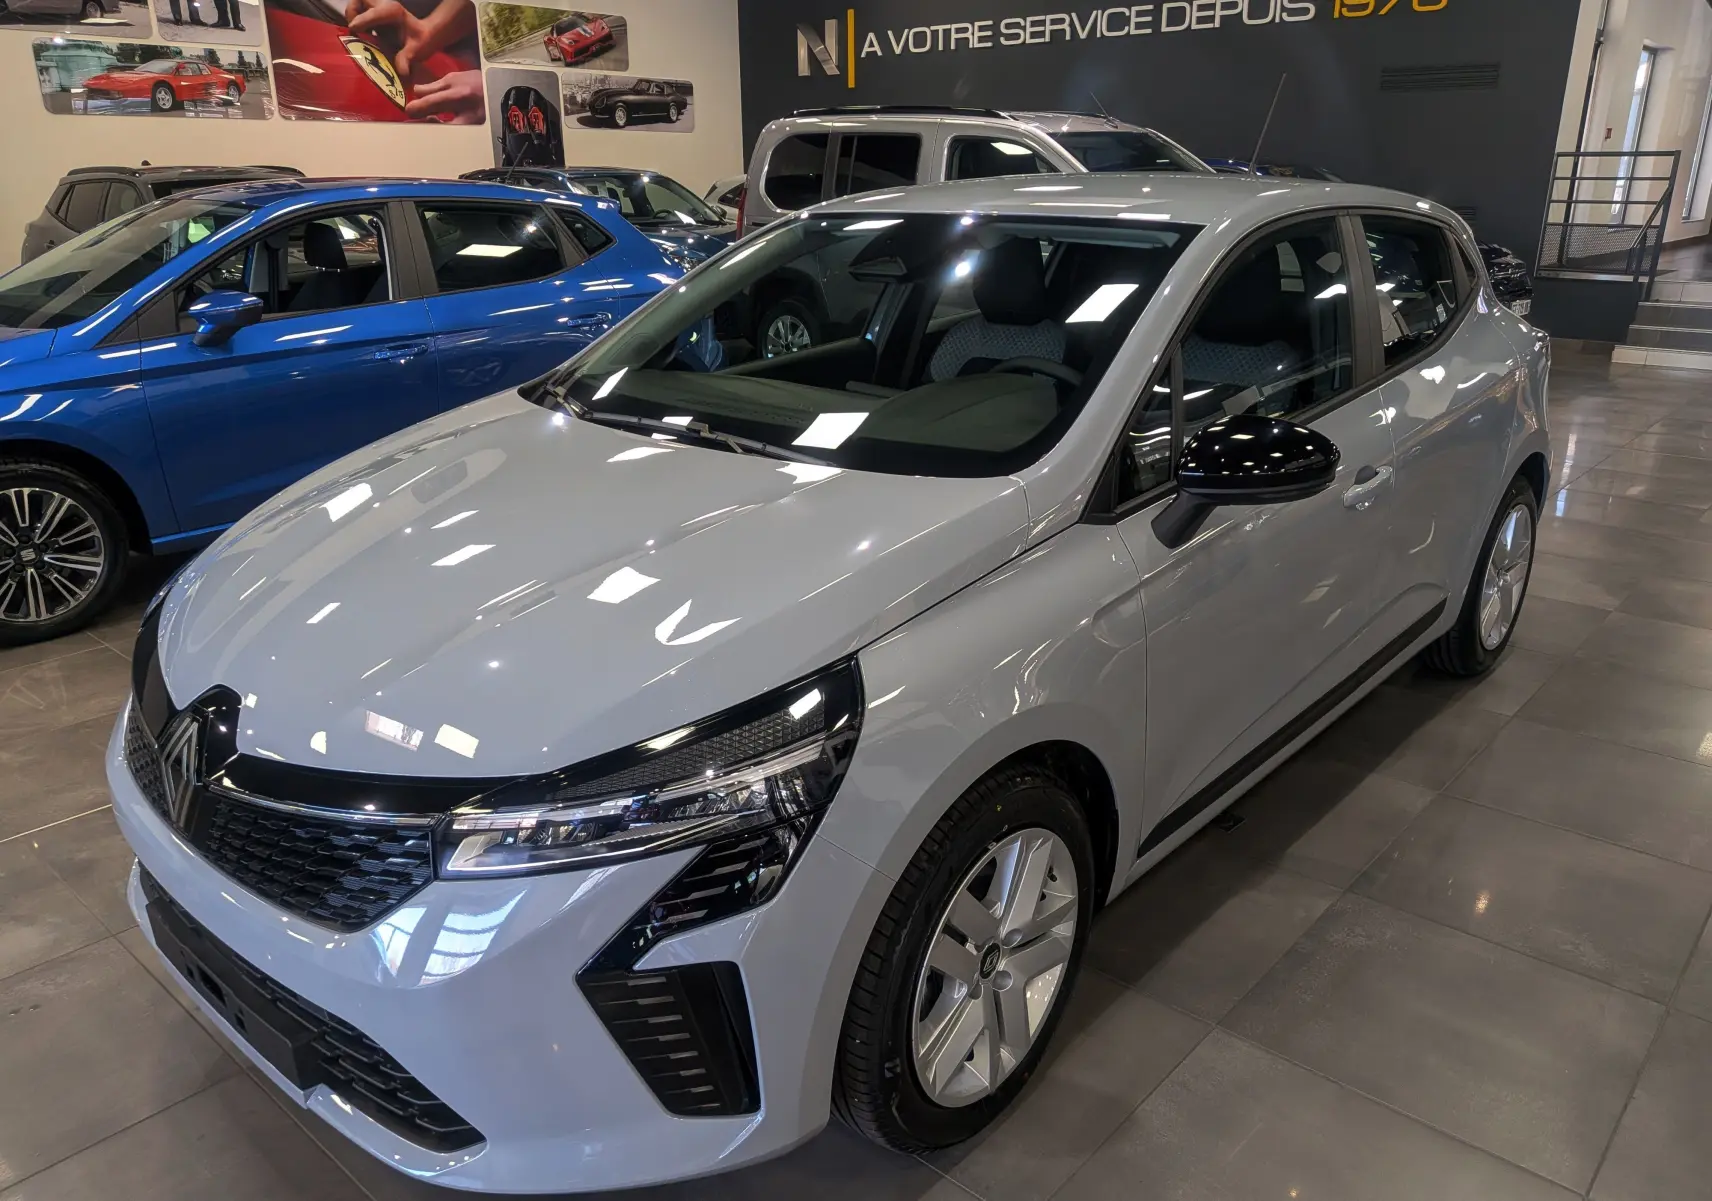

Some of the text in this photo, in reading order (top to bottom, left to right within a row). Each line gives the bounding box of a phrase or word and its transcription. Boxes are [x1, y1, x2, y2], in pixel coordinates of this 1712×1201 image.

[797, 19, 840, 77] N
[860, 32, 883, 58] A
[887, 20, 994, 55] VOTRE
[1000, 5, 1154, 46] SERVICE
[1160, 0, 1316, 33] DEPUIS
